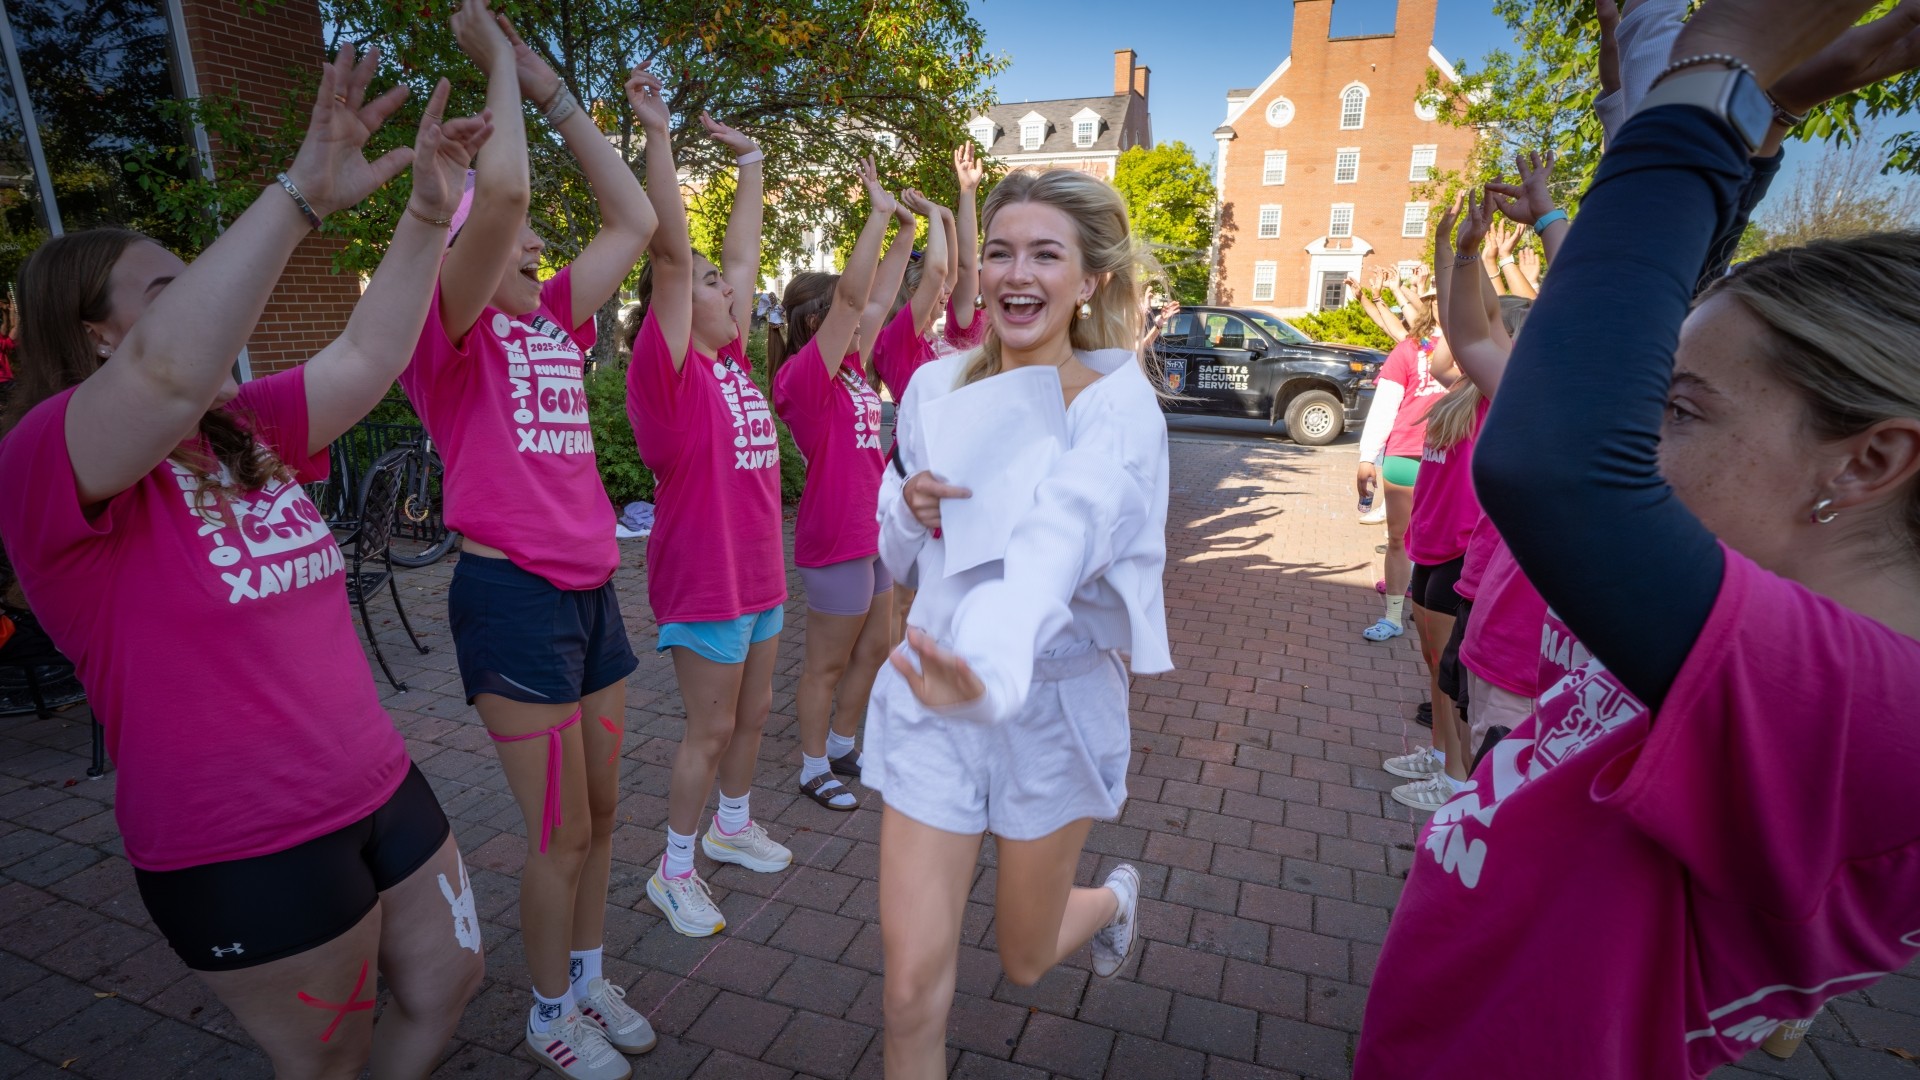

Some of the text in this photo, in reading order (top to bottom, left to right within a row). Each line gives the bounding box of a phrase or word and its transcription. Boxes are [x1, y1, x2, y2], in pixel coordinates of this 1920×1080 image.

[1198, 365, 1249, 374] SAFETY &
[1198, 373, 1250, 382] SECURITY
[1198, 381, 1249, 390] SERVICES
